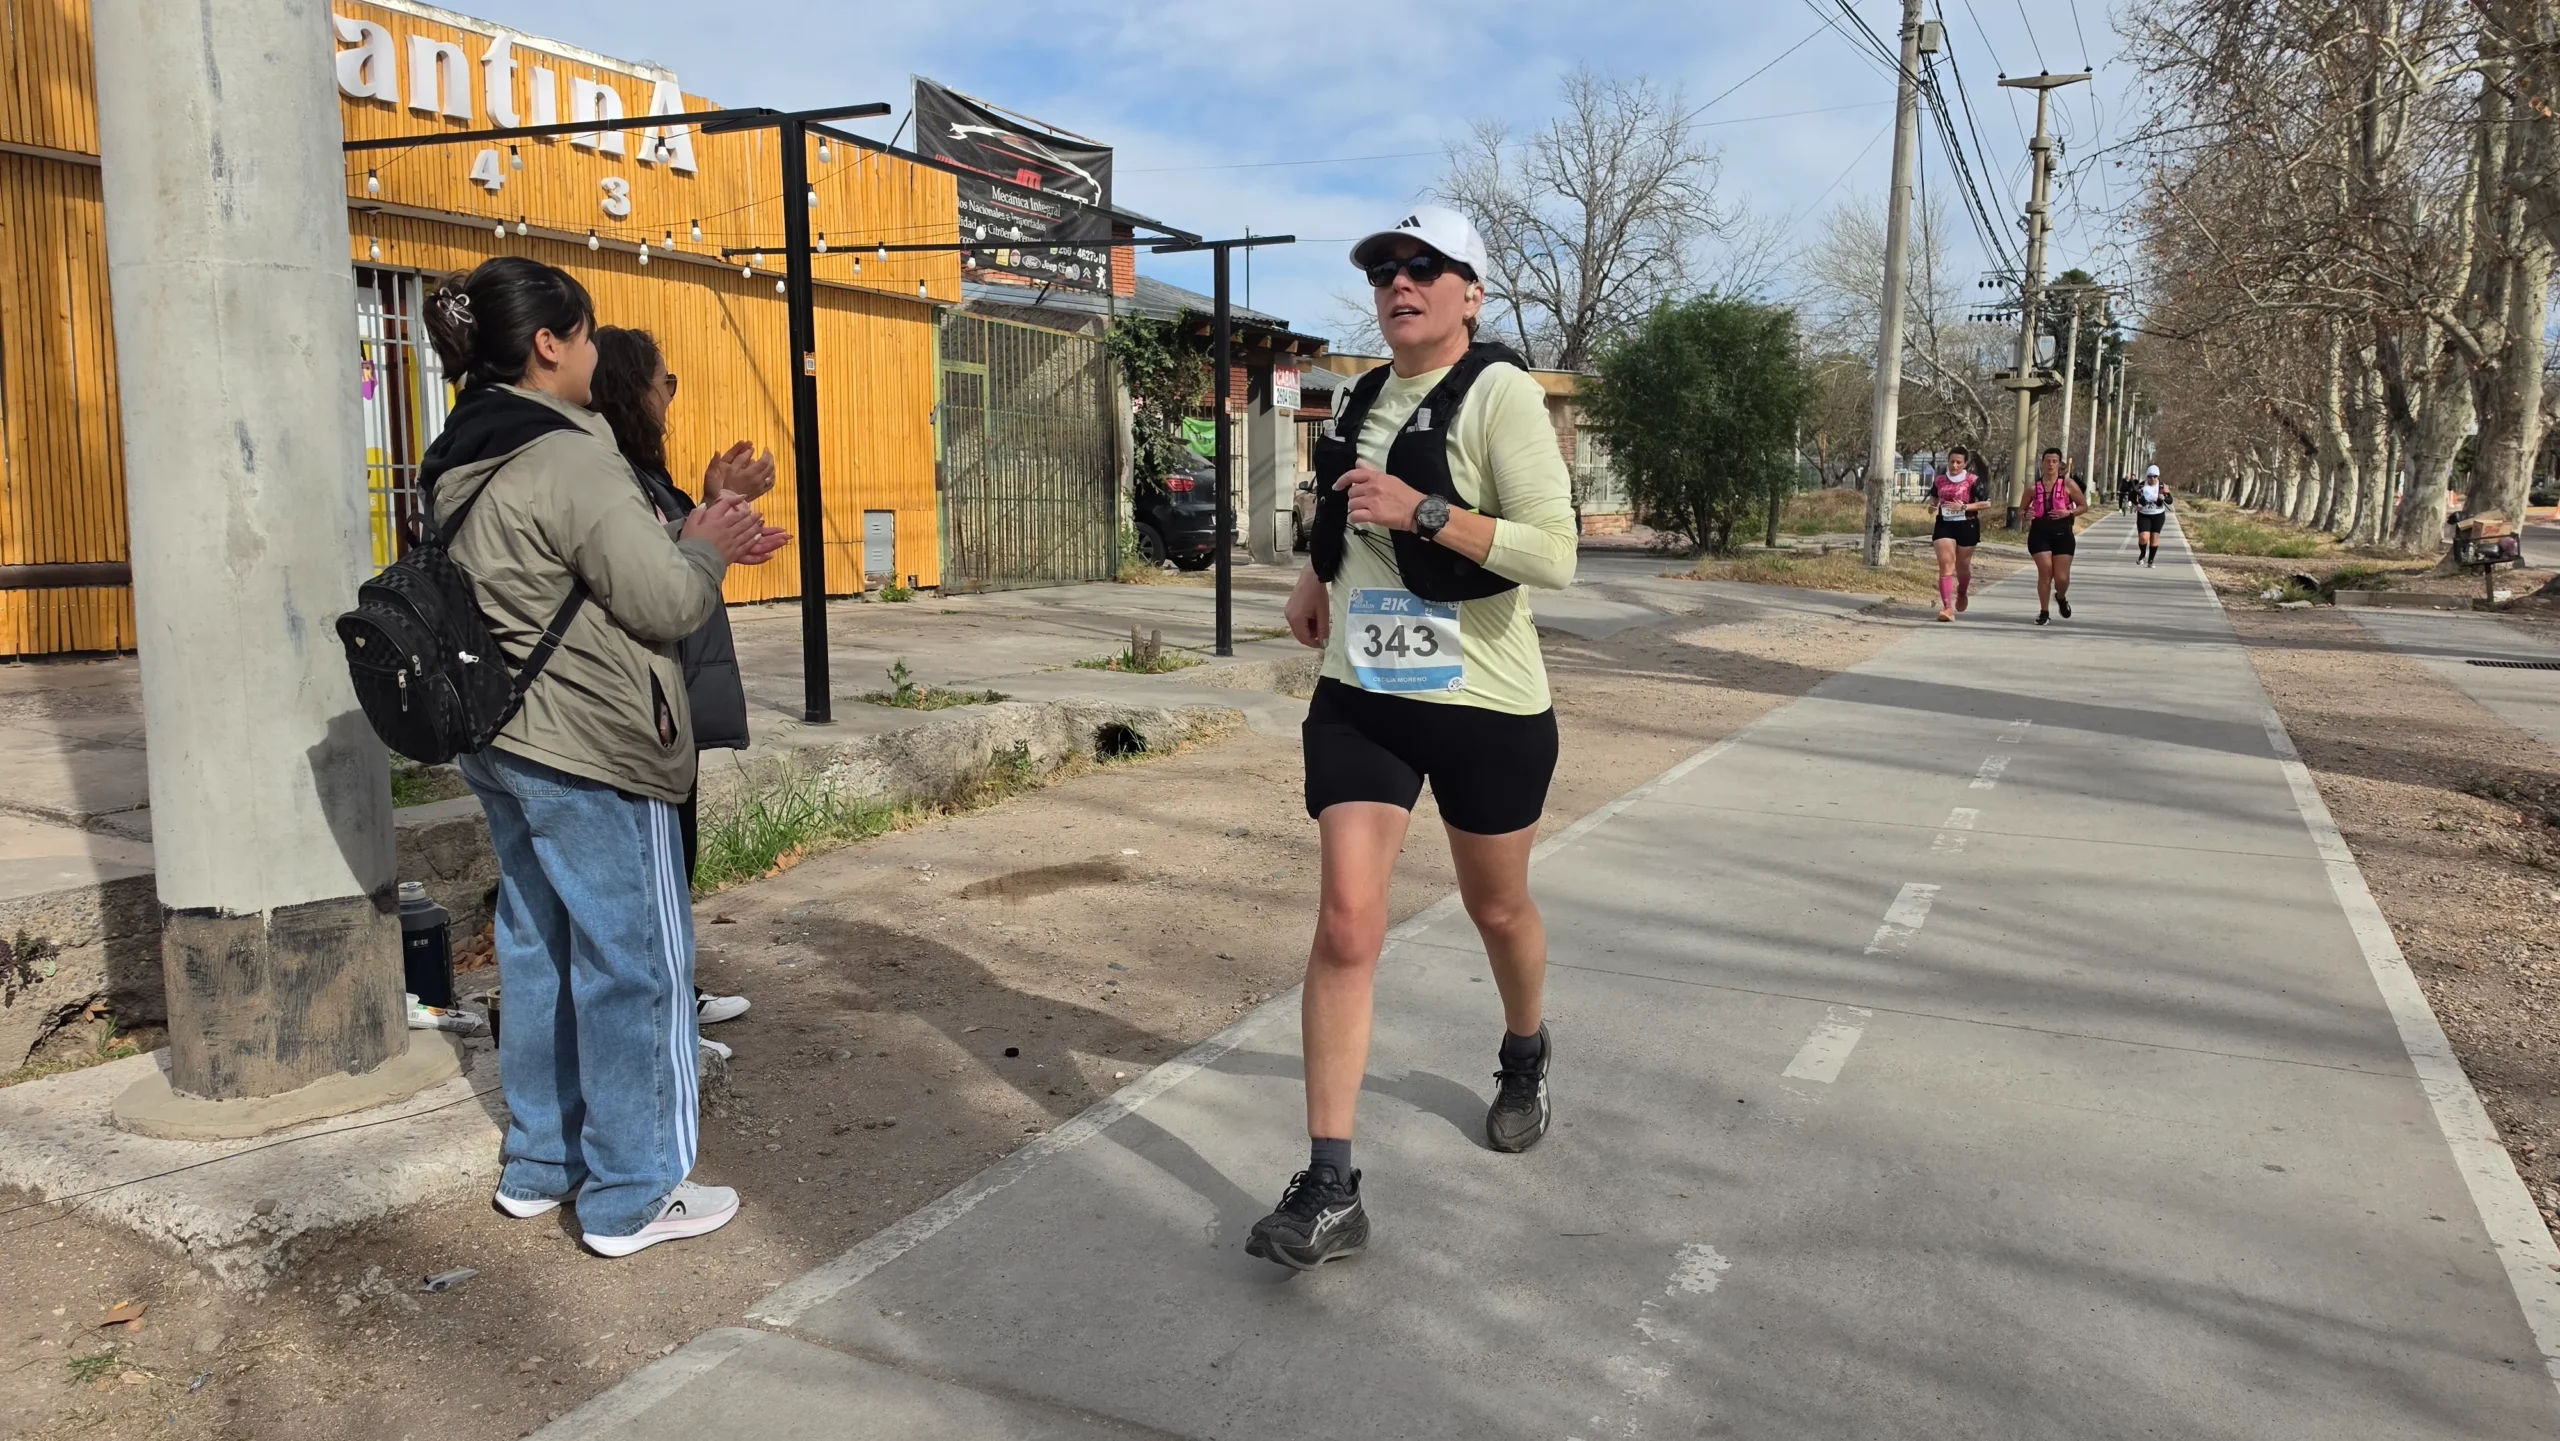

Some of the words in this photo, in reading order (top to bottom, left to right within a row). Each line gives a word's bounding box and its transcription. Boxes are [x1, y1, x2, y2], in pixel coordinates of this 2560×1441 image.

[469, 149, 505, 190] 4
[601, 177, 631, 216] 3
[969, 200, 1005, 221] Nacionales
[992, 185, 1029, 210] Mecánica
[1030, 197, 1061, 218] Integral
[1042, 260, 1057, 273] Jeep
[1380, 598, 1411, 611] 21K
[1363, 624, 1439, 657] 343
